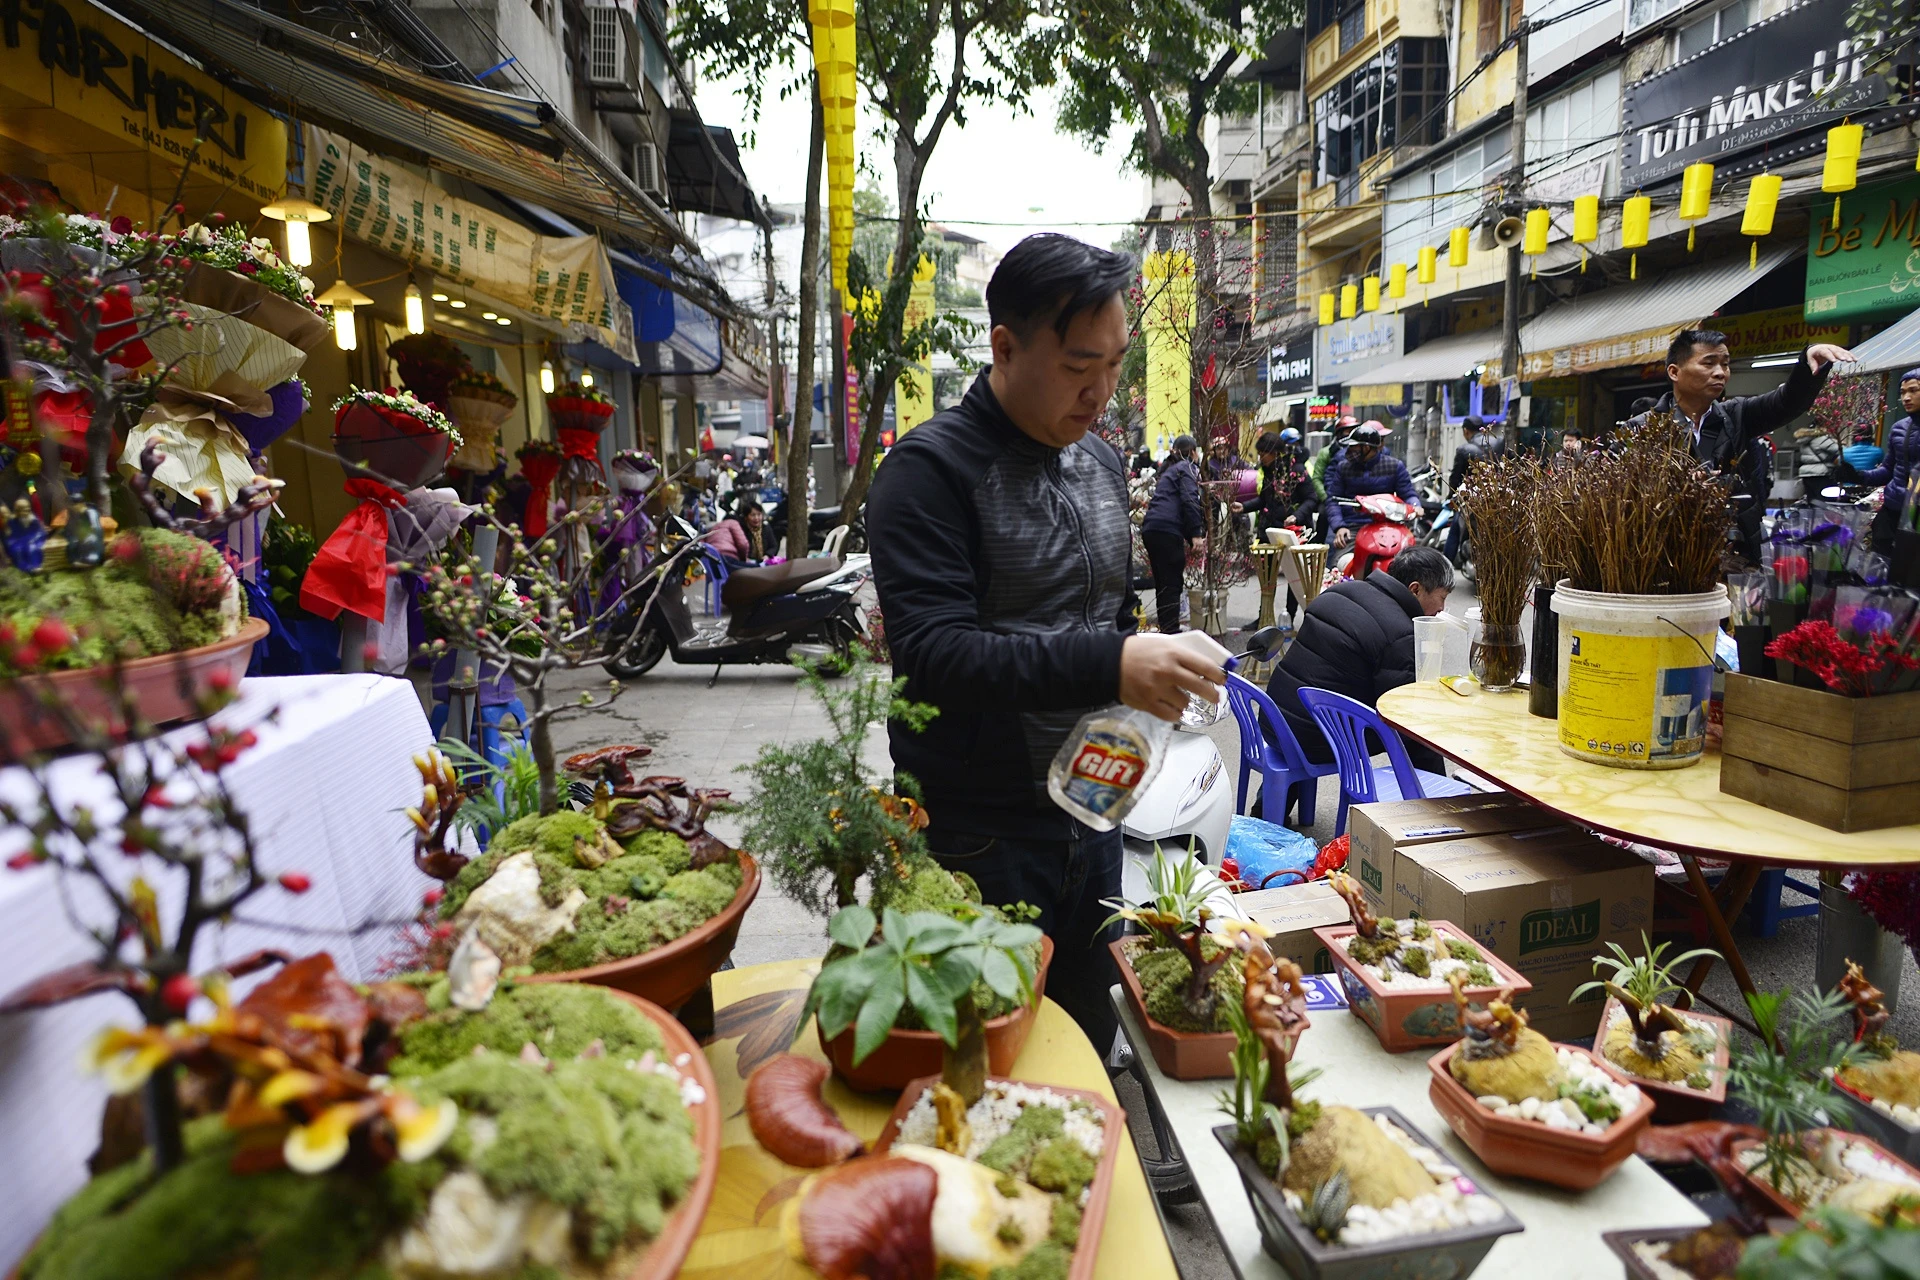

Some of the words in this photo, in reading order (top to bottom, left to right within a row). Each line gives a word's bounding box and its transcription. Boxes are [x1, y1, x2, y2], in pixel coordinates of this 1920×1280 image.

[326, 143, 341, 160] 2
[1814, 212, 1865, 258] Bé
[1872, 197, 1920, 249] M
[1290, 357, 1311, 380] ANH
[1078, 752, 1139, 786] GIFT
[1362, 863, 1381, 889] IDEAL
[1527, 913, 1592, 943] IDEAL
